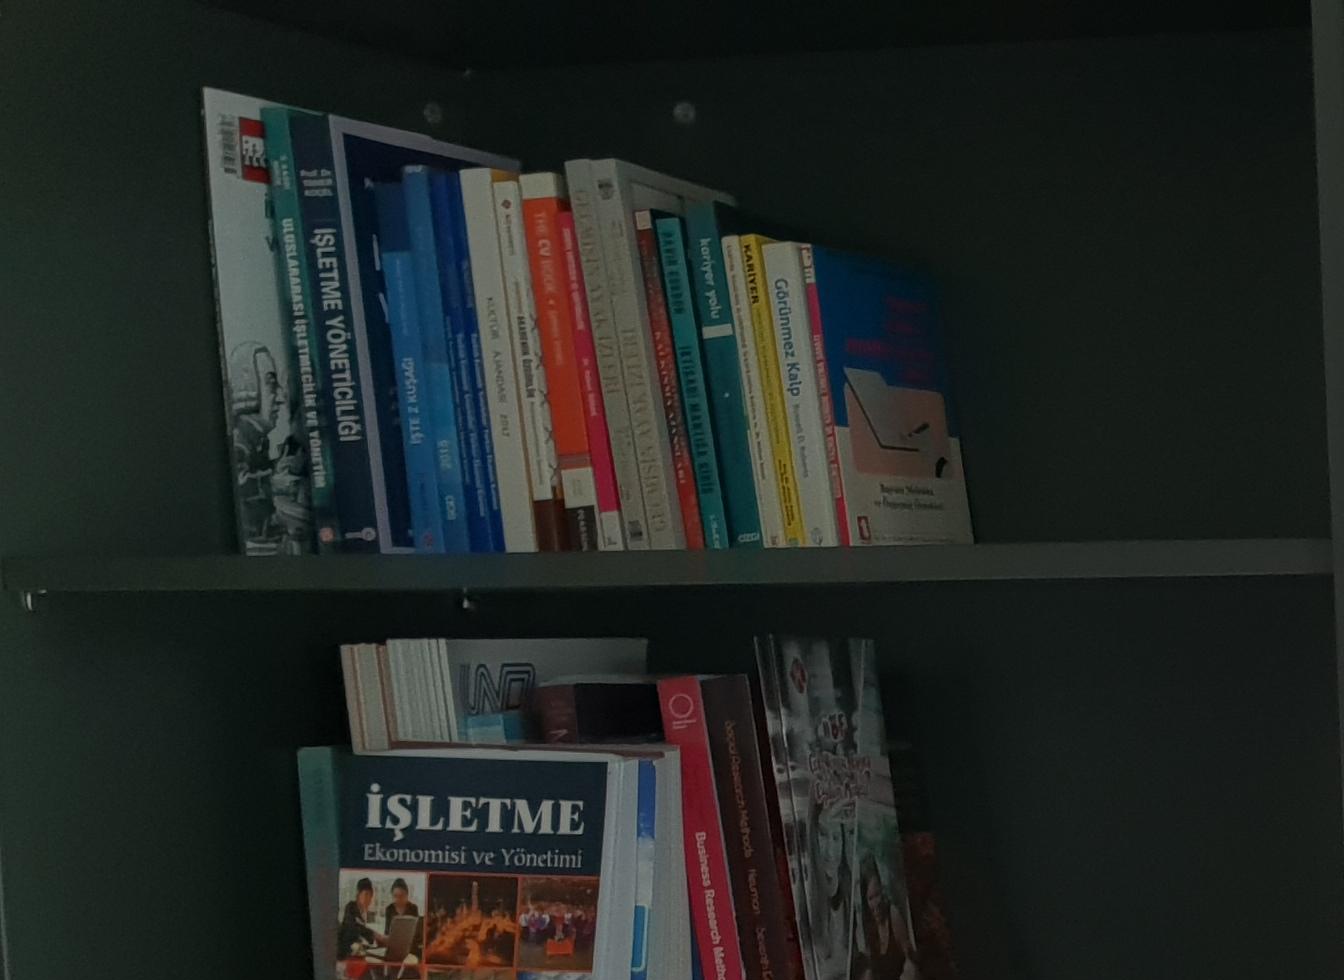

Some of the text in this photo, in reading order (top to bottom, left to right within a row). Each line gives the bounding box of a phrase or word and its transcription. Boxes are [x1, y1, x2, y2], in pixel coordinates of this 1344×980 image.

[308, 226, 345, 311] İŞLETME
[536, 237, 552, 257] CV
[742, 242, 761, 304] KARİYER
[696, 237, 722, 319] kariyer yolu
[773, 276, 804, 398] Görünmez Kalp
[323, 313, 363, 442] YÖNETİCİLİĞİ
[365, 782, 585, 842] İŞLETME
[363, 843, 584, 868] Ekonomisi ve Yönetimi
[694, 831, 713, 887] Business
[703, 888, 721, 944] Research
